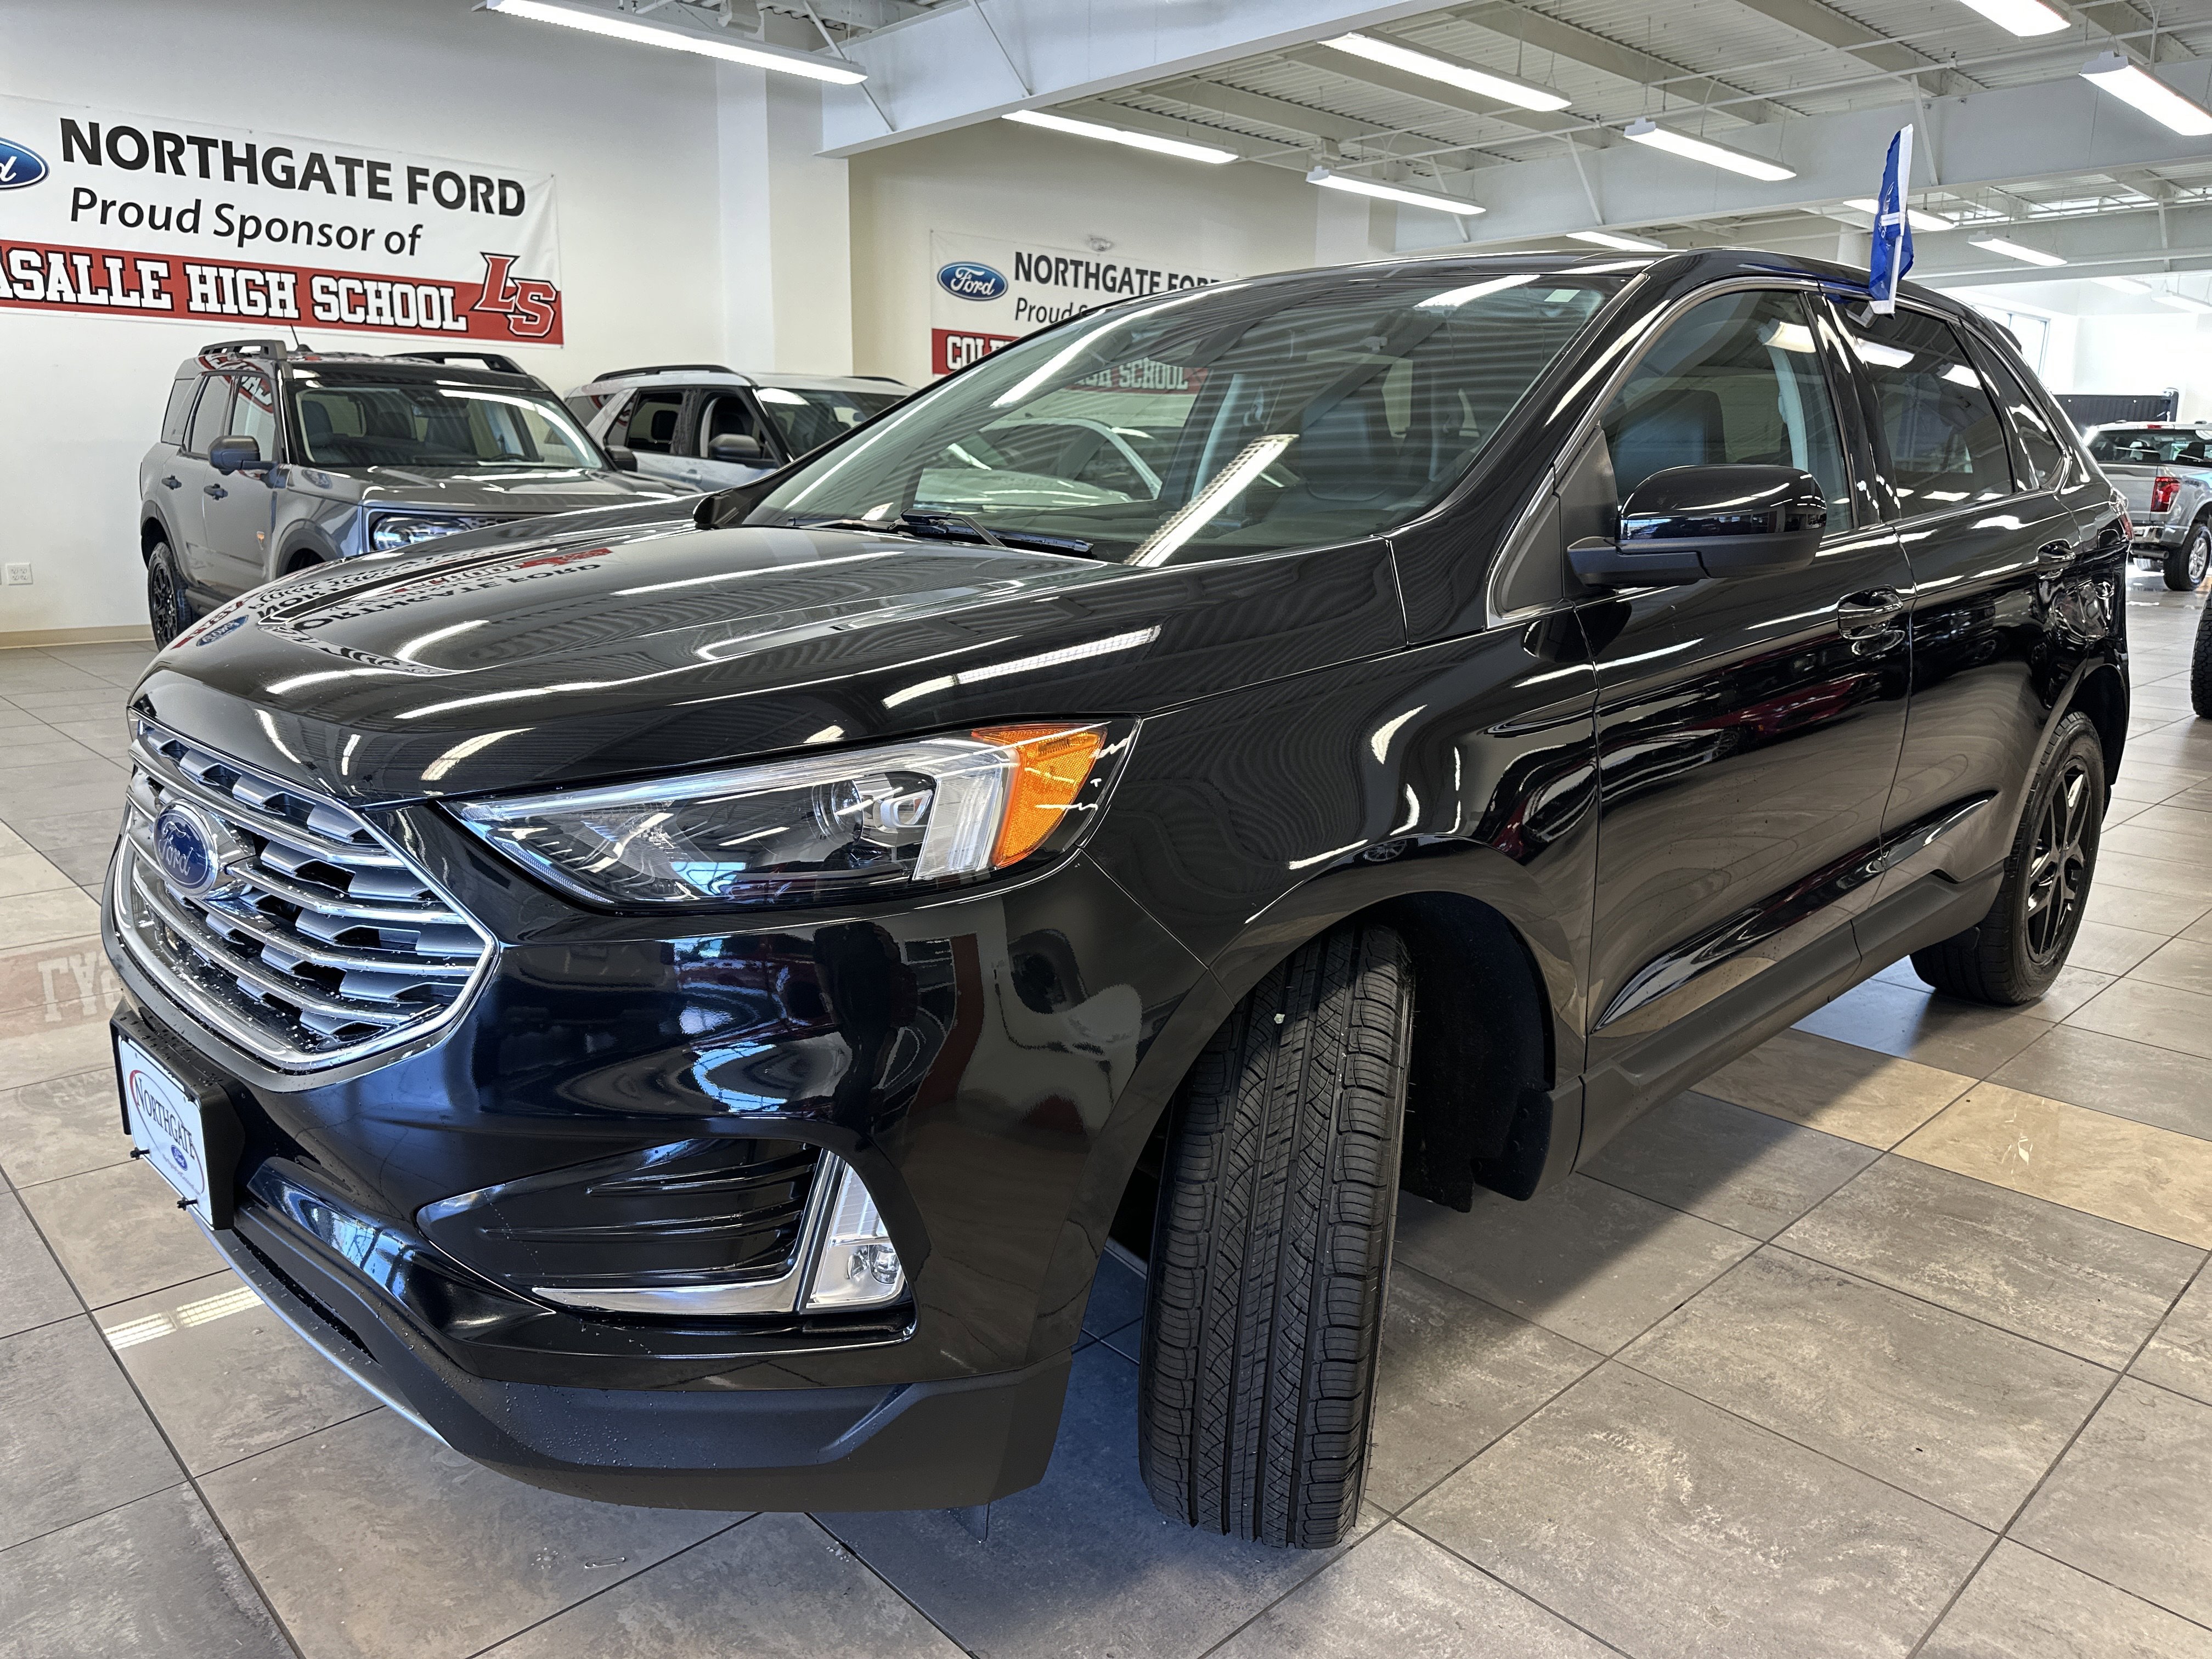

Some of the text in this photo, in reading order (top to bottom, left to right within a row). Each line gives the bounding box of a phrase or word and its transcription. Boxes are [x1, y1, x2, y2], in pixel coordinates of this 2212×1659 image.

[60, 117, 392, 202] NORTHGATE
[407, 166, 525, 217] FORD
[71, 187, 424, 256] Proud Sponsor of
[183, 262, 301, 319] HIGH
[311, 274, 468, 332] SCHOOL
[469, 251, 558, 338] LS
[950, 267, 996, 296] Ford
[1014, 251, 1161, 295] NORTHGATE
[1118, 358, 1189, 391] SCHOOL
[158, 821, 191, 876] Ford
[134, 1074, 195, 1161] NORTHGATE
